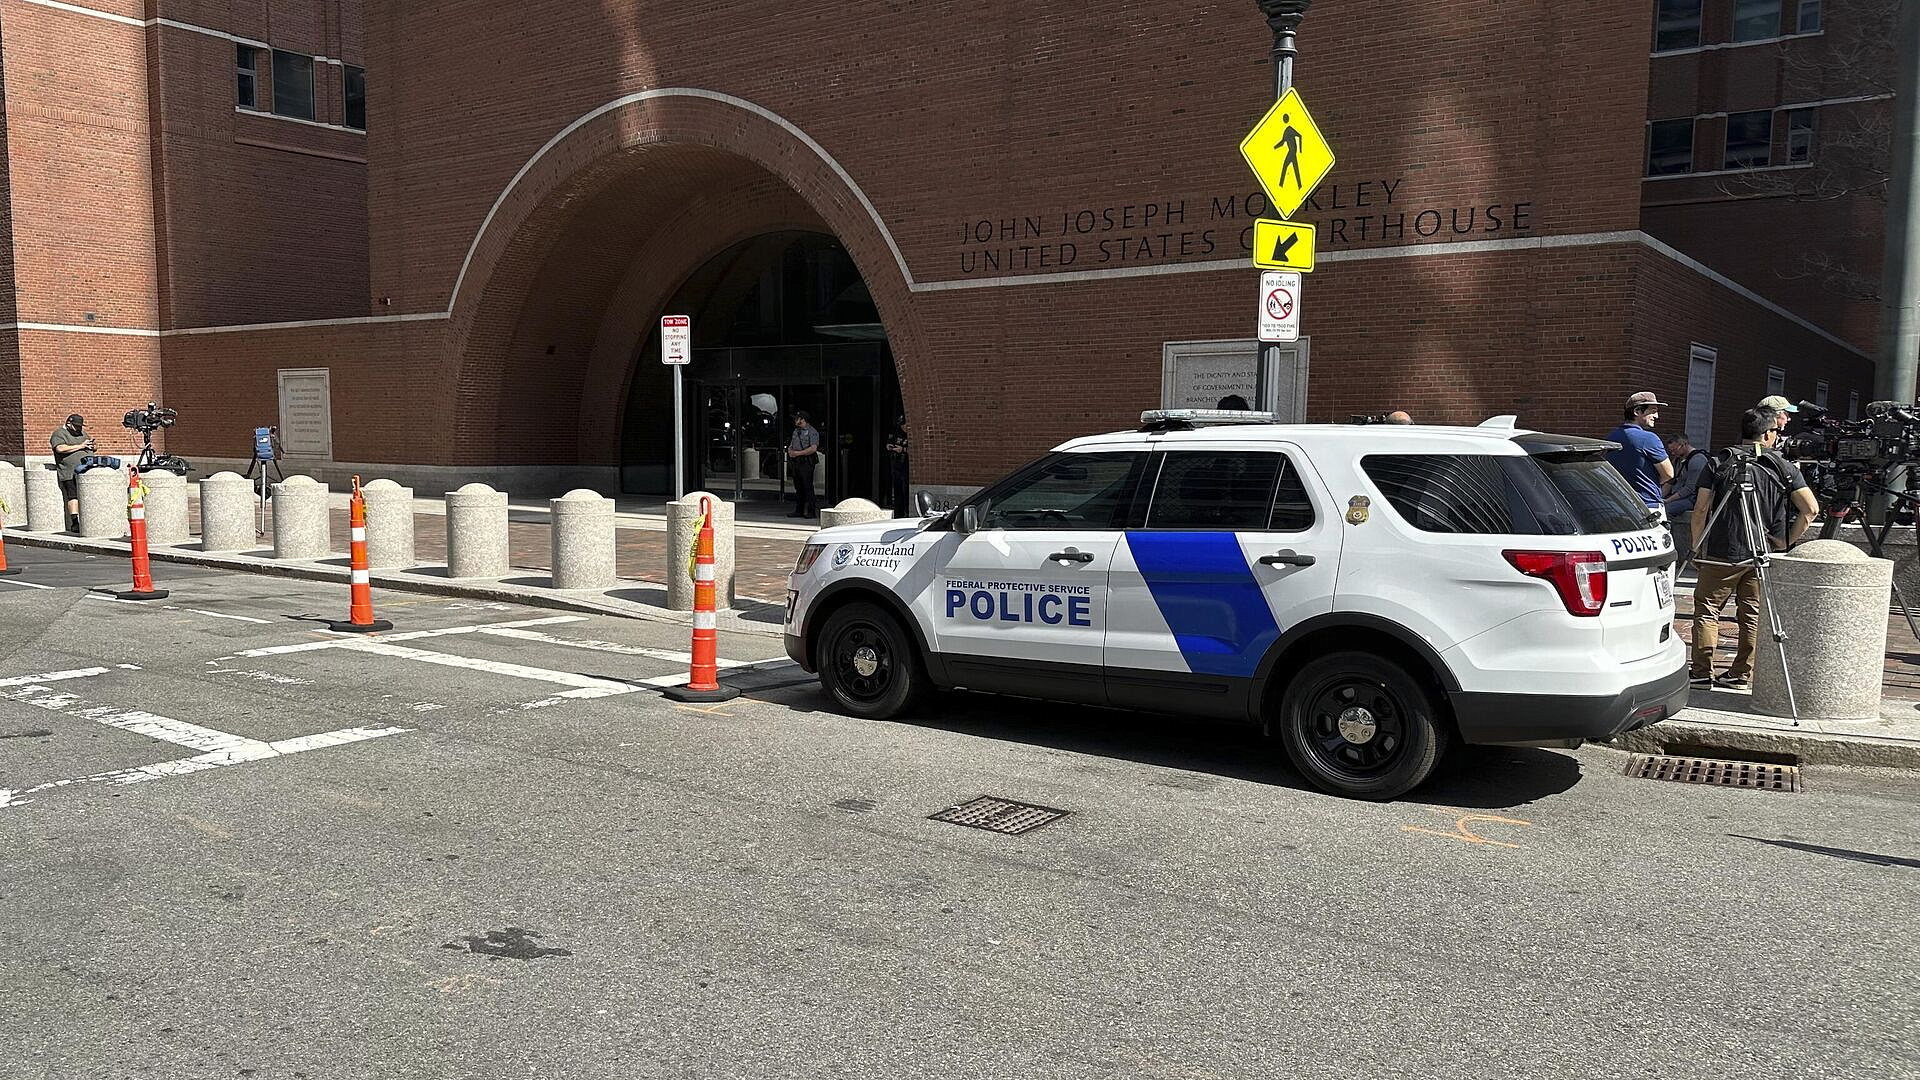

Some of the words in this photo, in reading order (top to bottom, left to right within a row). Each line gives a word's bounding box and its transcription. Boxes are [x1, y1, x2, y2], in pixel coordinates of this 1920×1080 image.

[963, 215, 1042, 245] JOHN
[1062, 200, 1186, 237] JOSEPH
[1210, 178, 1401, 220] MOKLEY
[961, 243, 1078, 273] UNITED
[1098, 230, 1216, 262] STATES
[1239, 202, 1531, 250] CRTHOUSE
[859, 543, 916, 557] Homeland
[1611, 535, 1658, 555] POLICE
[853, 556, 901, 573] Security
[946, 580, 986, 590] FEDERAL
[987, 582, 1046, 592] PROTECTIVE
[1048, 584, 1090, 595] SERVICE
[946, 589, 1091, 627] POLICE
